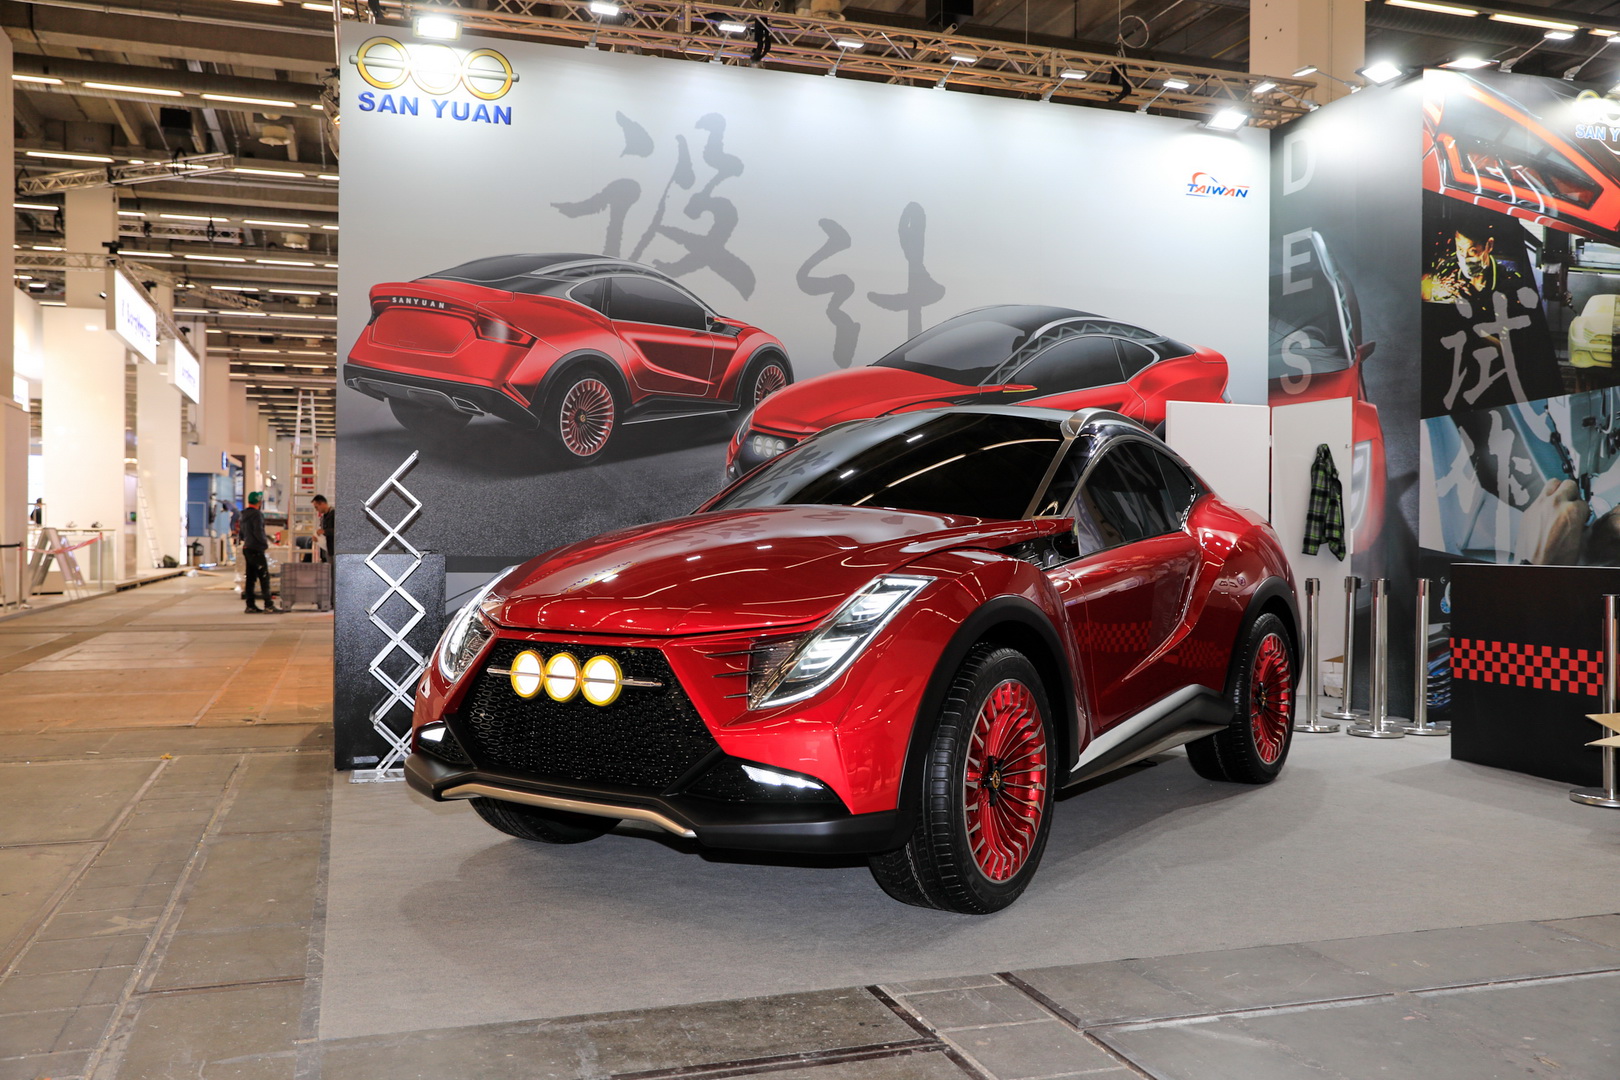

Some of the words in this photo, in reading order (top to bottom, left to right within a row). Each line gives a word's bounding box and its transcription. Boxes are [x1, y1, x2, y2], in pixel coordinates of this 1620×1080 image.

[358, 91, 419, 116] SAN
[431, 99, 512, 126] YUAN
[1575, 123, 1607, 141] SAN
[1187, 183, 1249, 198] TAIWAN
[391, 296, 445, 309] SANYUAN
